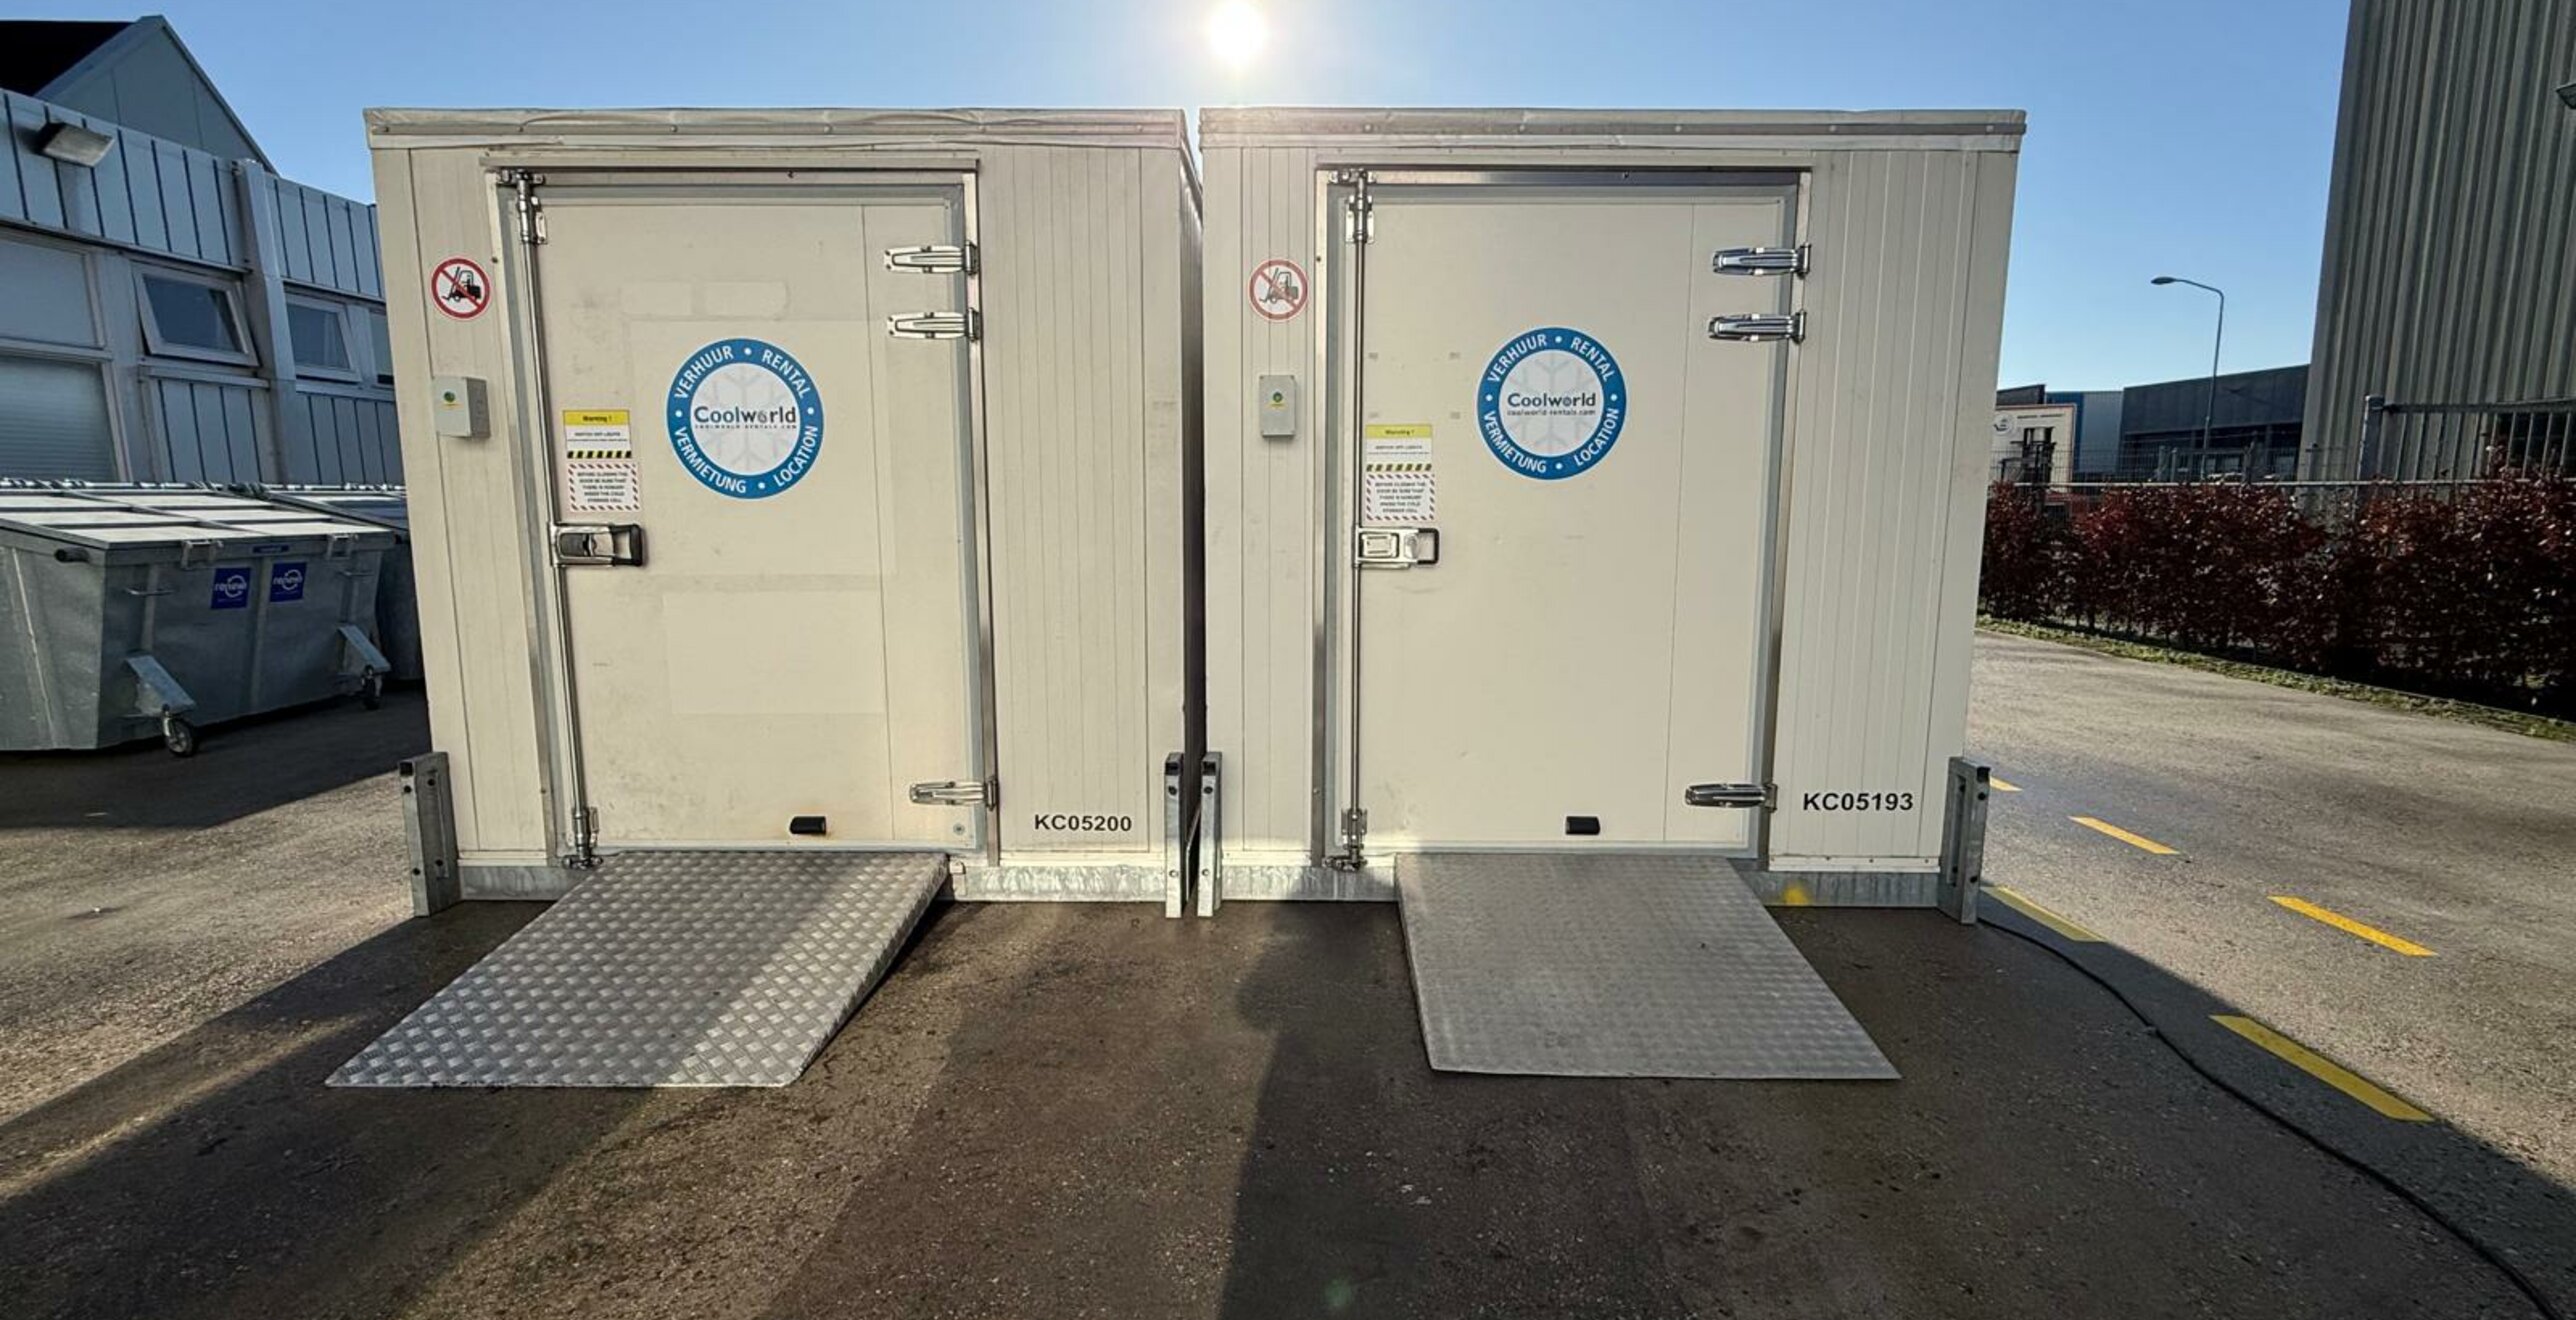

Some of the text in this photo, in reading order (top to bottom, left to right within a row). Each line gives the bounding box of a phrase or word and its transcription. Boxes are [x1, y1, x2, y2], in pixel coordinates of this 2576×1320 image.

[674, 345, 734, 400] VERHUUR
[761, 349, 811, 399] RENTAL
[1487, 334, 1548, 383] VERHUUR
[1571, 337, 1616, 382] RENTAL
[694, 406, 796, 423] Coolworld
[1507, 392, 1596, 407] Coolworld
[674, 426, 746, 494] VERMIETUNG
[773, 425, 818, 488] LOCATION
[1484, 410, 1547, 473] VERMIETUNG
[1573, 408, 1619, 467] LOCATION
[1034, 814, 1132, 831] KC05200
[1803, 792, 1913, 811] KC05193
